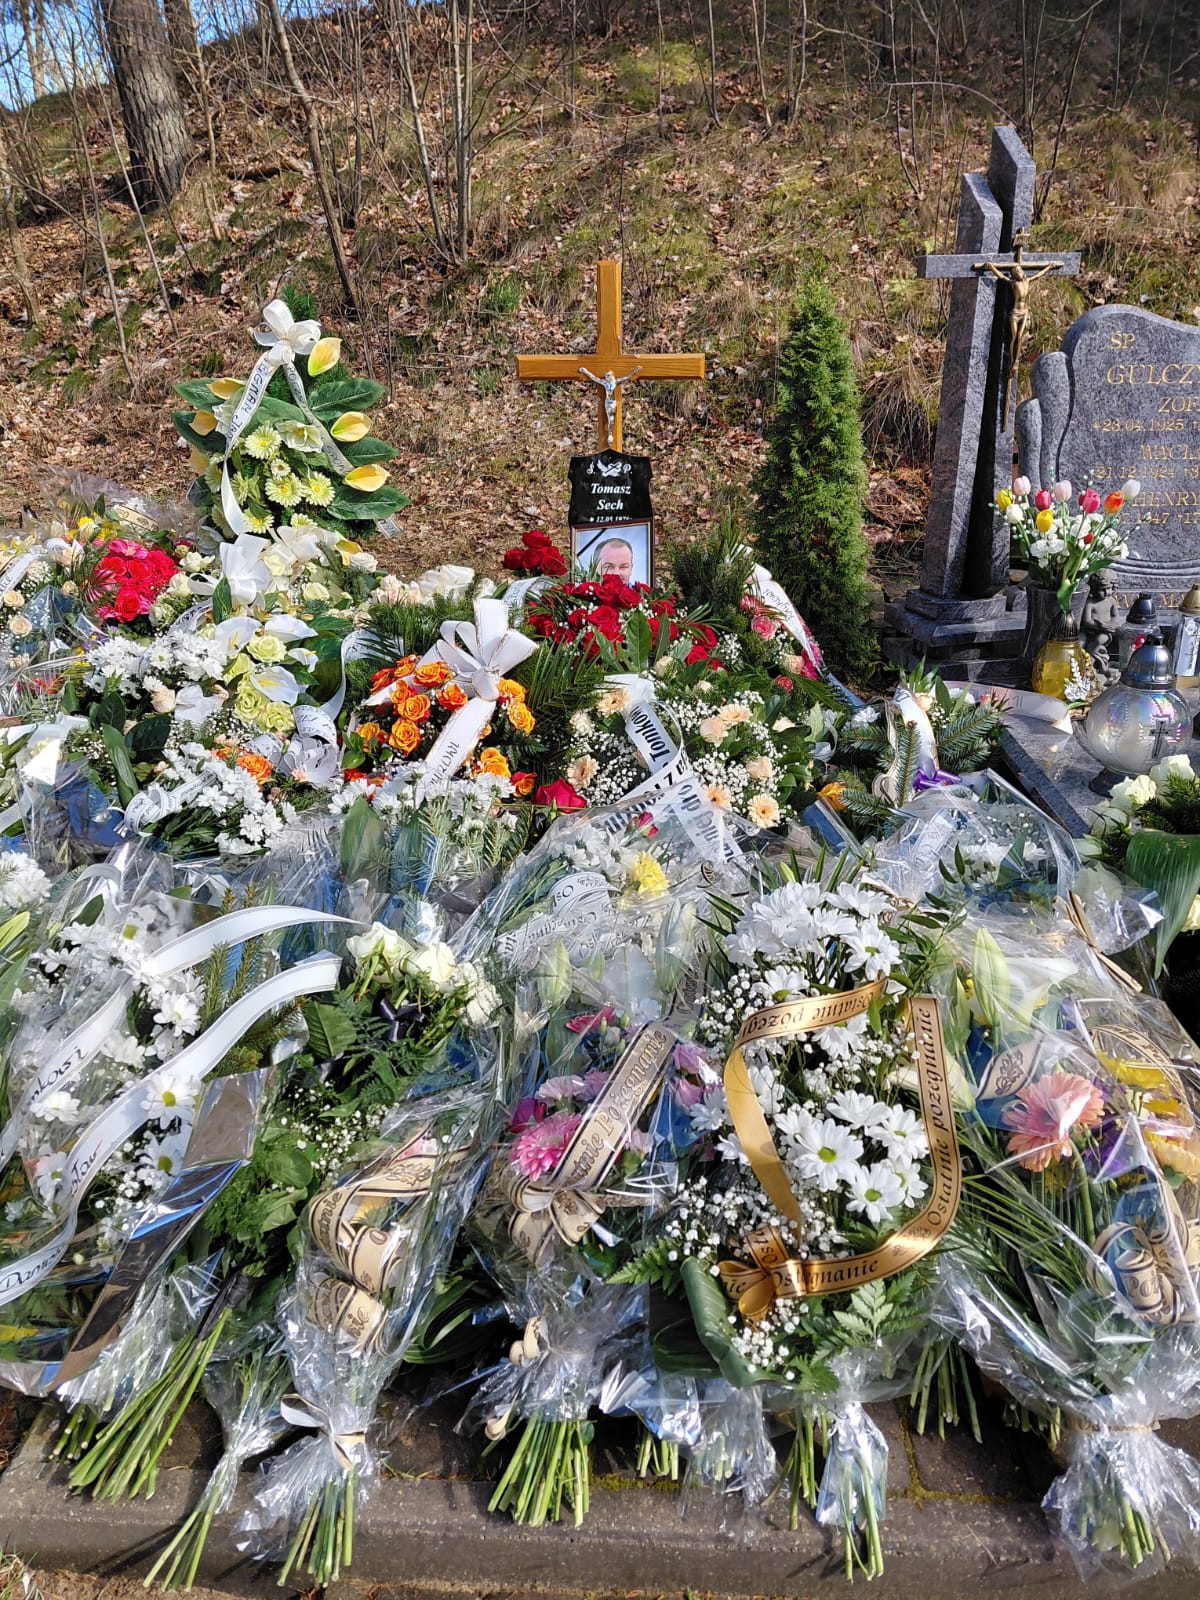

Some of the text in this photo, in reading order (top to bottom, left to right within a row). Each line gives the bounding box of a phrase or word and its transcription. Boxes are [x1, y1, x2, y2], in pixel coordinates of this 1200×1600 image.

[1107, 363, 1200, 384] GULCZ
[591, 482, 631, 495] Tomasz
[597, 499, 624, 510] Sech
[928, 1139, 953, 1227] Ostatnie
